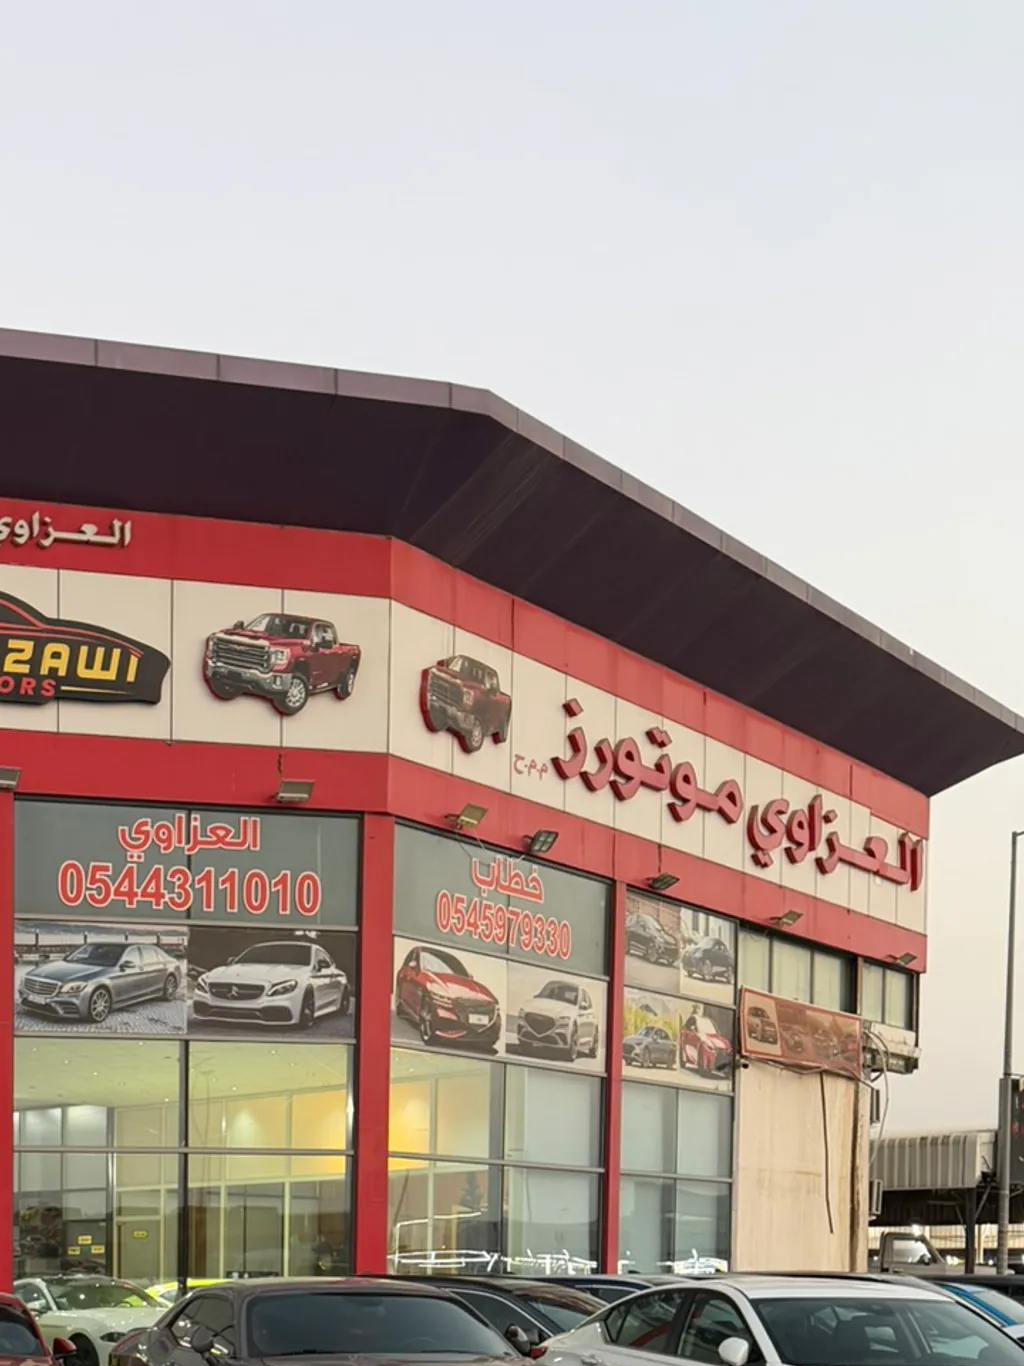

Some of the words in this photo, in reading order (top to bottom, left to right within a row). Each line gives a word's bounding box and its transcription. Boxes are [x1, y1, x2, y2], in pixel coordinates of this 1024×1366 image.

[550, 698, 744, 825] موتورز
[118, 813, 261, 862] العزاوي
[746, 794, 924, 892] العزاوي
[58, 860, 322, 917] 0544311010
[471, 855, 544, 904] خطاب
[436, 889, 572, 961] 0545979330
